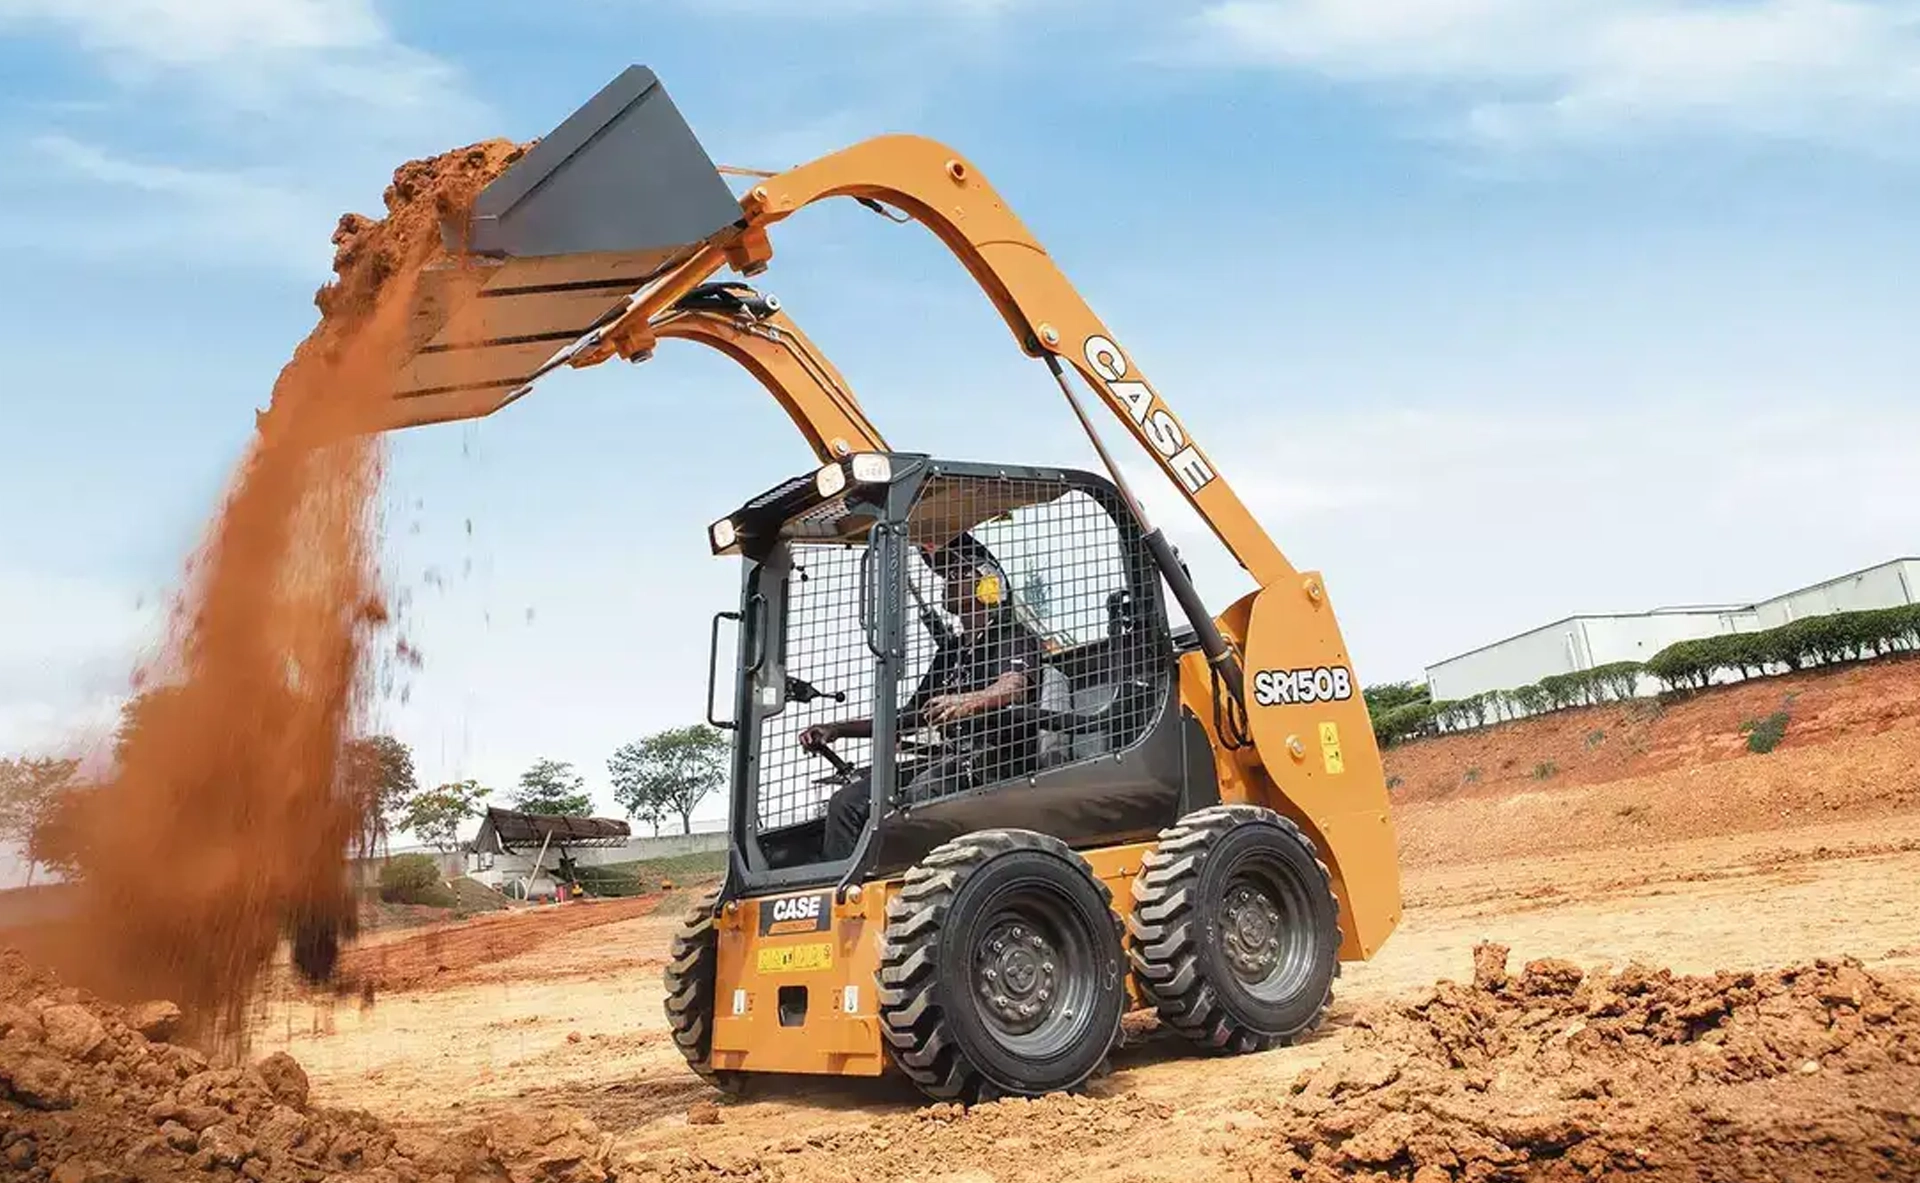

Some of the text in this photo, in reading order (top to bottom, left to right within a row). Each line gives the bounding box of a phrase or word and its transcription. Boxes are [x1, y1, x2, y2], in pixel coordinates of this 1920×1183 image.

[1084, 335, 1216, 494] CASE
[1254, 665, 1352, 705] SR150B
[773, 896, 821, 921] CASE
